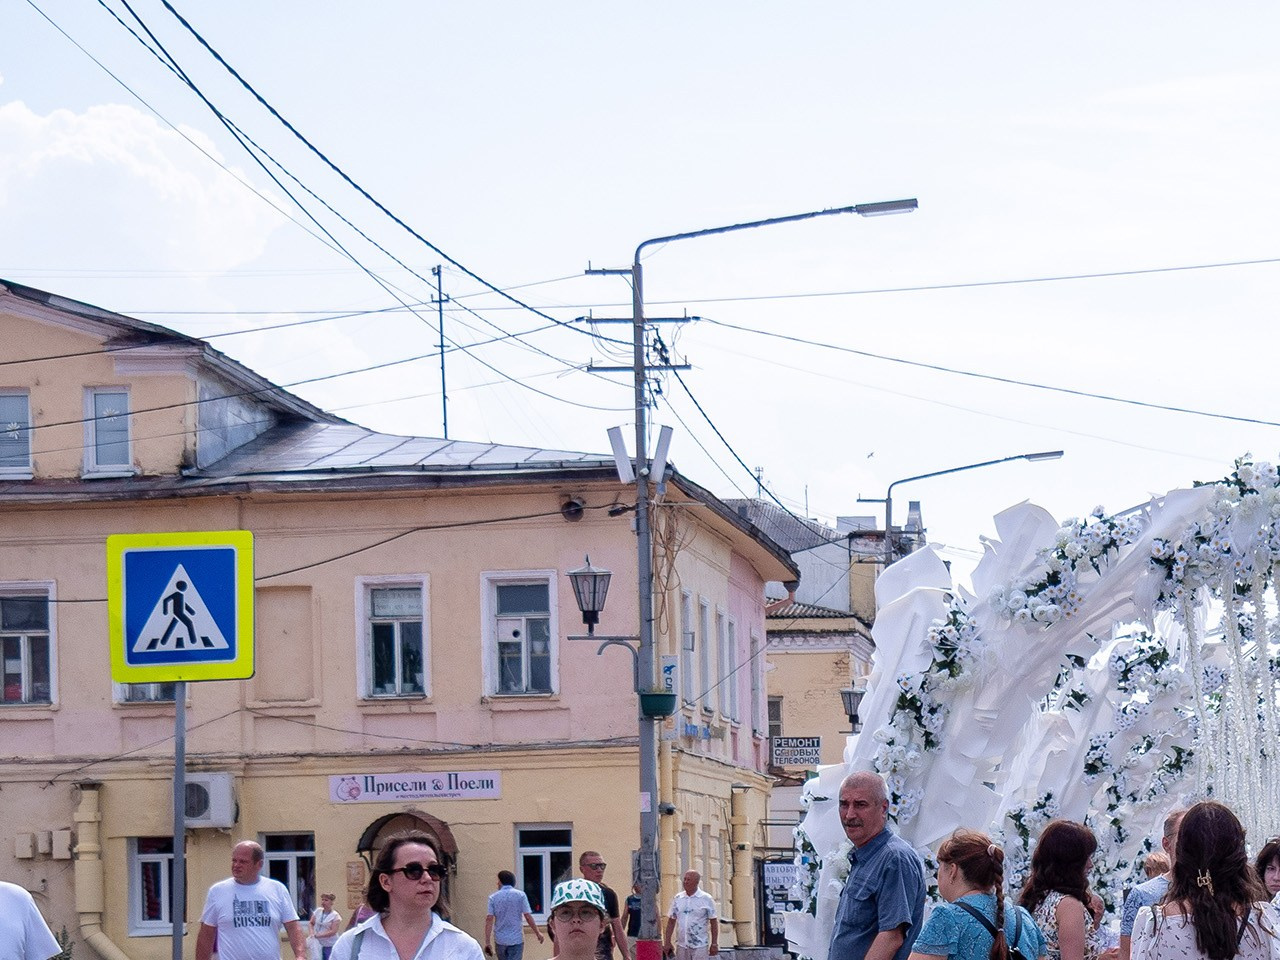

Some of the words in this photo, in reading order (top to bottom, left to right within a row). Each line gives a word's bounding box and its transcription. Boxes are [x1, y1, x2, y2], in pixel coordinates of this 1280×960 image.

[774, 738, 819, 747] РЕМОНТ
[774, 757, 820, 765] ТЕЛЕФОНОВ
[364, 775, 427, 795] Присели
[447, 773, 494, 790] Поели
